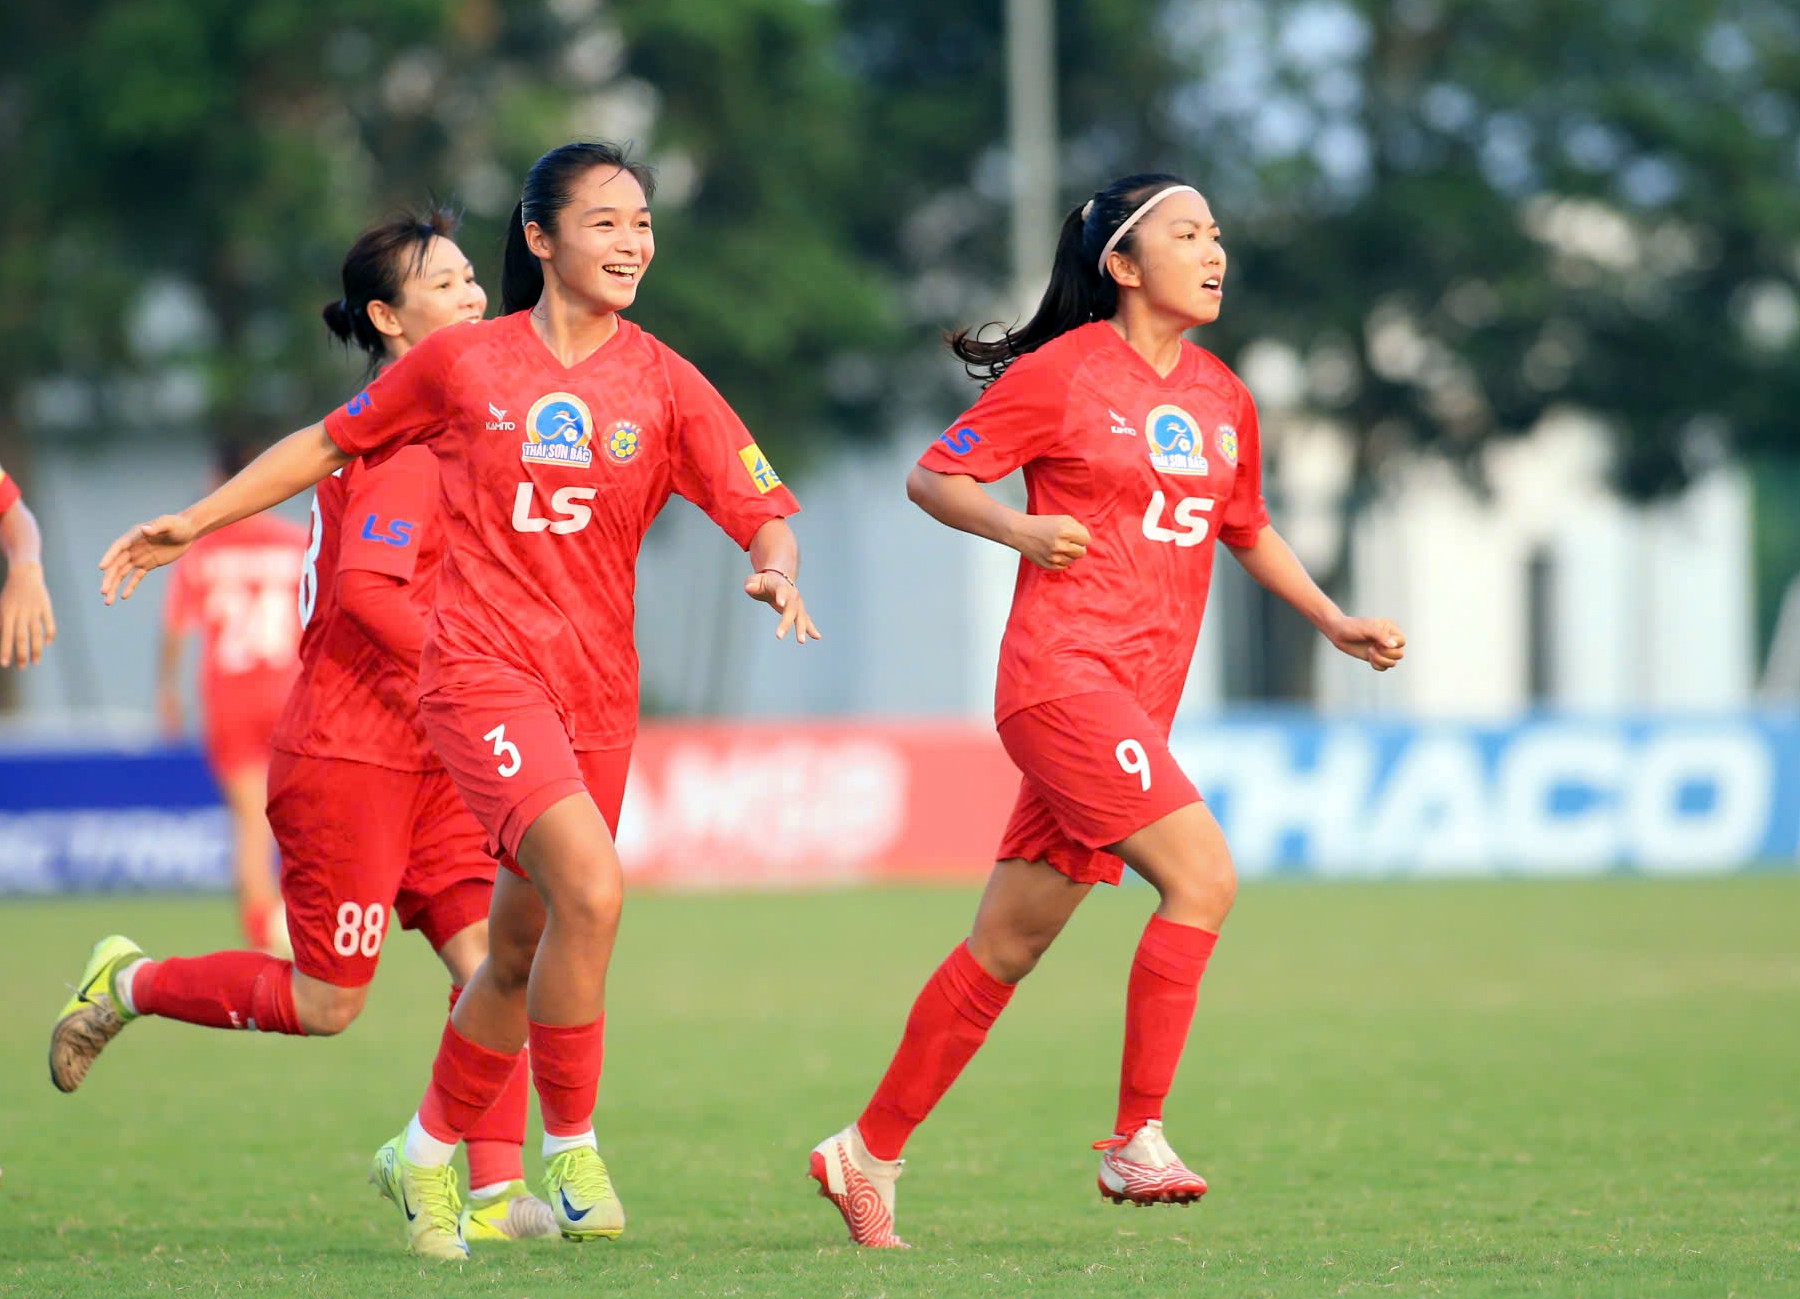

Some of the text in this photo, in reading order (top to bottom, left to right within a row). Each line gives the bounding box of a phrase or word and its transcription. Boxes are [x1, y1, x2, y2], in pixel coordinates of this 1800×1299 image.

[361, 513, 413, 547] LS
[512, 482, 597, 535] LS
[1142, 490, 1215, 547] LS
[484, 724, 521, 778] 3
[1115, 738, 1151, 791] 9
[334, 902, 384, 957] 88
